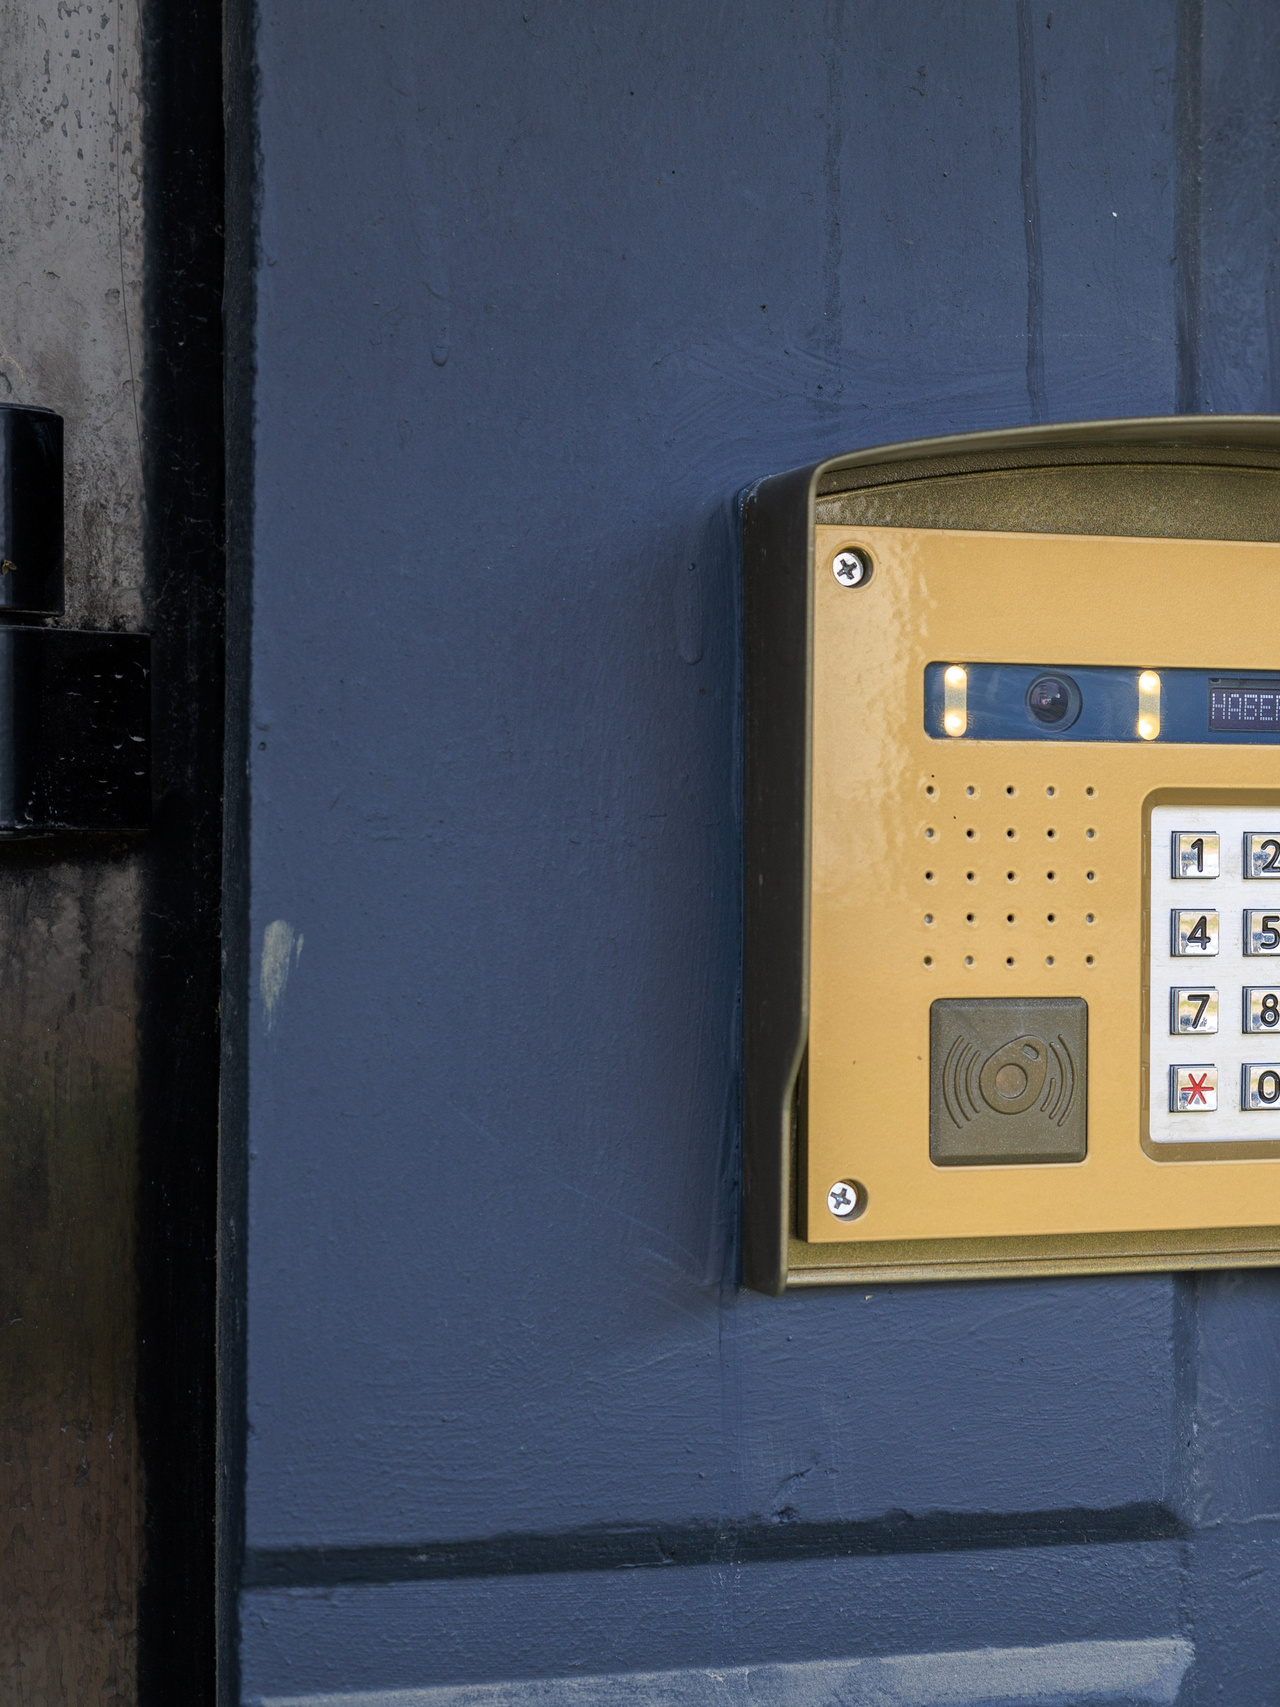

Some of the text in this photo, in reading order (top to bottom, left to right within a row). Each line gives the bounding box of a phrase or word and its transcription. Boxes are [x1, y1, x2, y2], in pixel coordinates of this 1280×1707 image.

[1190, 838, 1204, 872] 1
[1187, 915, 1211, 950] 4
[1261, 916, 1280, 949] 5
[1187, 994, 1210, 1029] 7
[1260, 994, 1280, 1027] 8
[1257, 1070, 1280, 1104] 0
